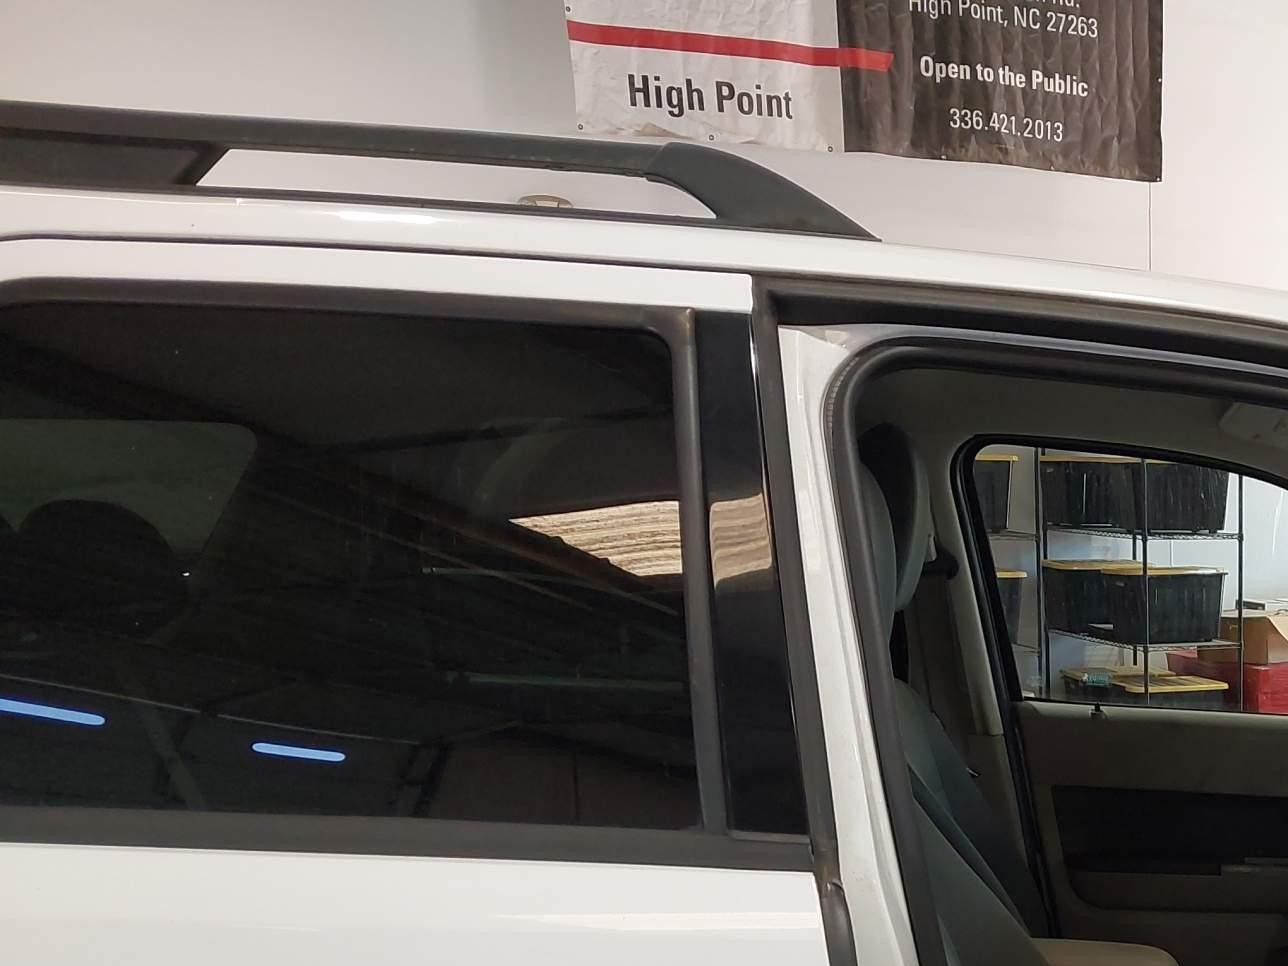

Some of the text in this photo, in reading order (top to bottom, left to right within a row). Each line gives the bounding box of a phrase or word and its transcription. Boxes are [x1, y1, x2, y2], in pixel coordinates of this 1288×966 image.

[909, 0, 1098, 38] High Point, NC 27263
[920, 55, 1089, 97] Open to the Public
[627, 73, 793, 120] High Point
[949, 107, 1064, 142] 336.421.2013
